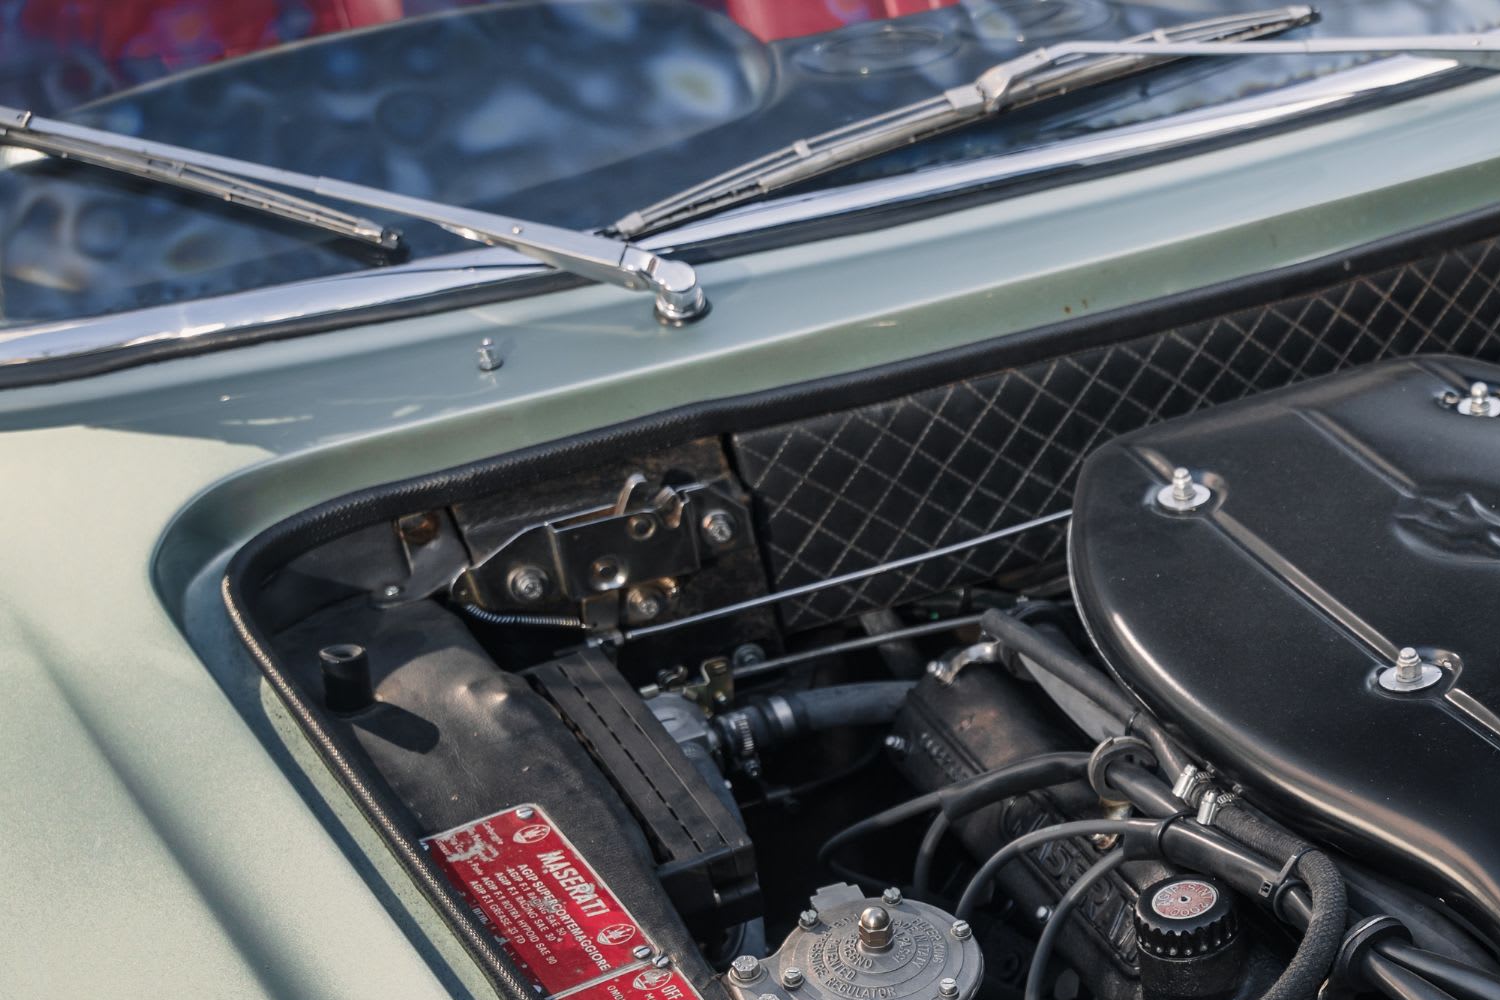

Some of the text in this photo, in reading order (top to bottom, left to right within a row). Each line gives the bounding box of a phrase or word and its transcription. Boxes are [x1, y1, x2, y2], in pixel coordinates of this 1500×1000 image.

[469, 880, 486, 895] AGIP
[488, 904, 512, 926] GREASE
[507, 925, 519, 934] 33
[514, 935, 526, 944] FD
[494, 871, 511, 886] AGIP
[514, 896, 537, 917] RACING
[533, 919, 547, 931] SAE
[544, 932, 556, 941] 30
[506, 868, 523, 882] AGIP
[526, 892, 548, 913] RACING
[545, 914, 559, 927] SAE
[555, 927, 566, 936] 50
[516, 863, 612, 972] AGIP SUPERCORTEMAGGIORE
[537, 849, 610, 918] MASERATI
[480, 876, 497, 891] AGIP
[500, 901, 520, 920] ROTRA
[516, 920, 539, 942] HYPOID
[534, 942, 549, 955] SAE
[545, 955, 557, 965] 90
[825, 977, 896, 998] REGULATOR
[912, 942, 930, 968] ITALY
